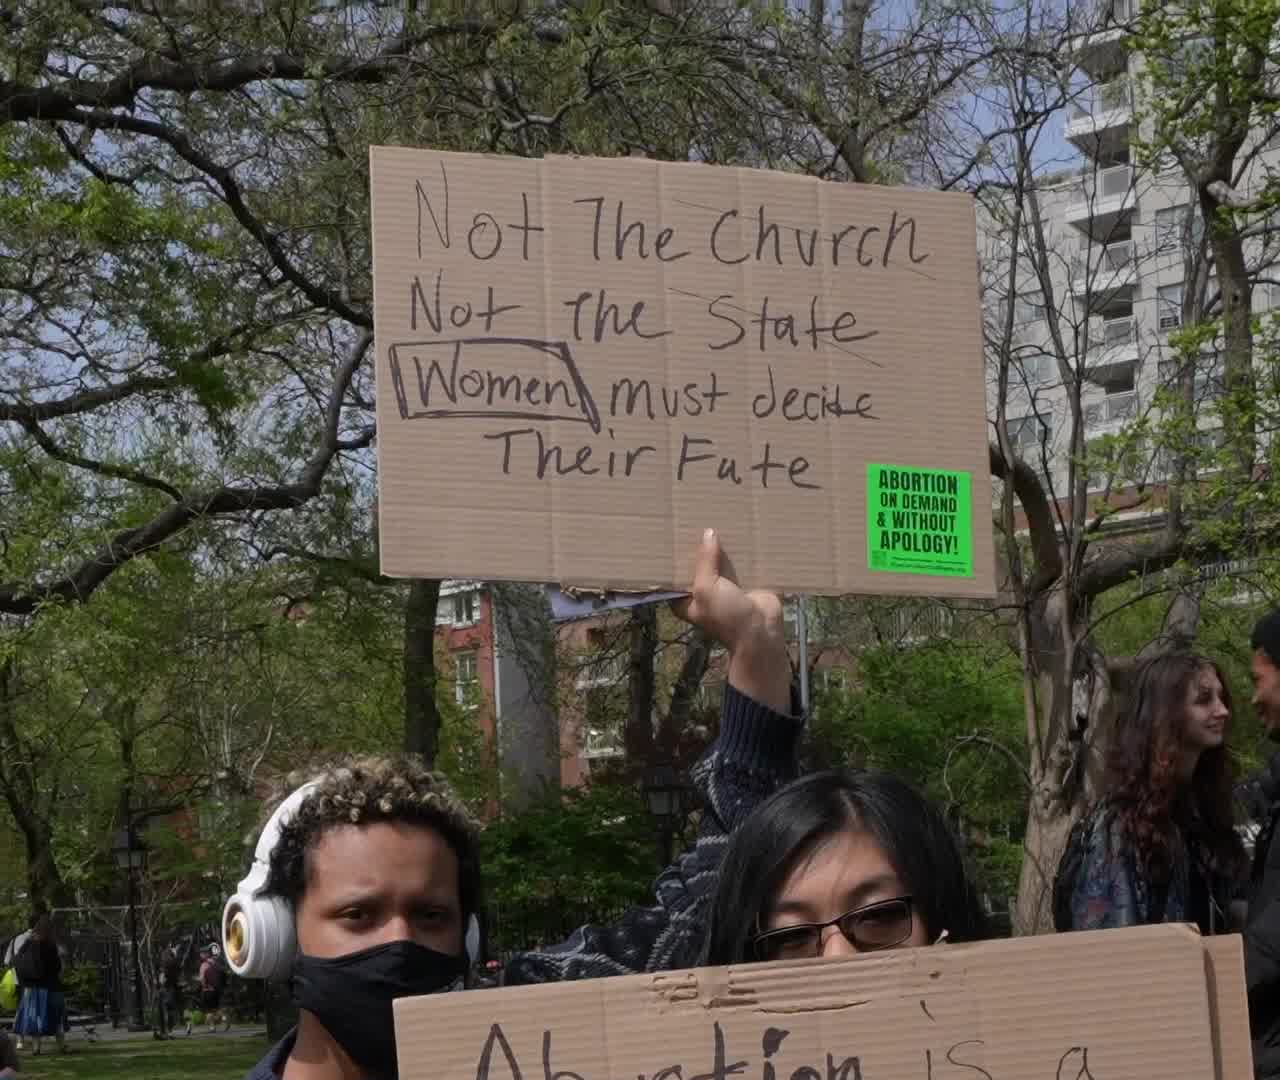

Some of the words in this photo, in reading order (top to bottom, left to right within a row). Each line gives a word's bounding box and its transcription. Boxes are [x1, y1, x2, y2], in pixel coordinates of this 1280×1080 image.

[415, 161, 543, 258] Not
[573, 197, 690, 262] The
[711, 205, 929, 268] Church
[411, 268, 521, 333] Not
[565, 290, 672, 341] The
[709, 294, 879, 350] State
[414, 343, 577, 408] Women
[609, 372, 728, 419] must
[483, 428, 657, 479] Their
[677, 434, 821, 489] Fate
[879, 469, 957, 495] ABORTION
[880, 492, 897, 508] ON
[903, 493, 957, 513] DEMAND
[877, 512, 886, 528] &
[892, 511, 956, 533] WITHOUT
[880, 530, 959, 555] APOLOGY!
